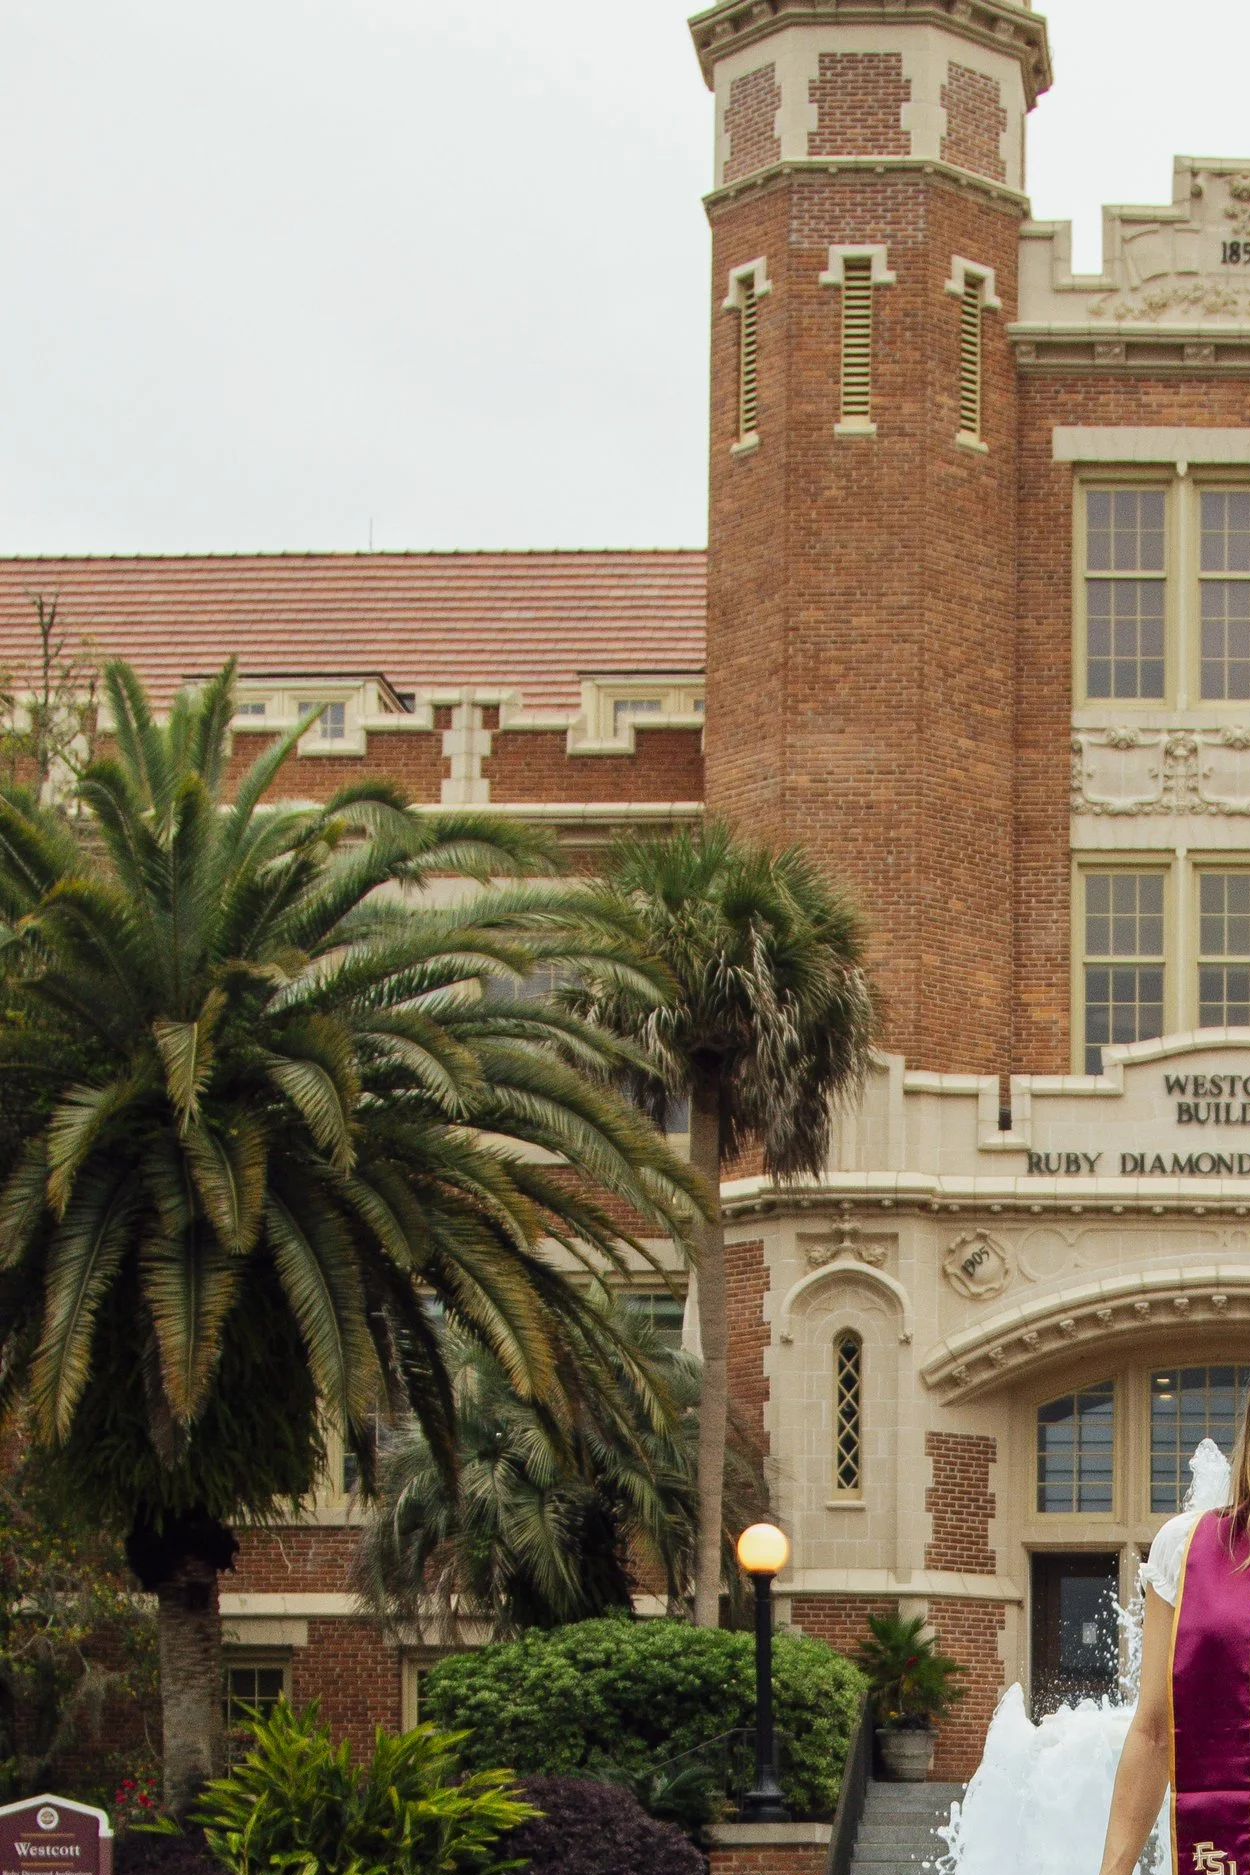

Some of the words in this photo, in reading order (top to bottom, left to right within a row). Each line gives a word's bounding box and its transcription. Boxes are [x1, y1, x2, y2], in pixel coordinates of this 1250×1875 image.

[1027, 1152, 1103, 1175] RUBY
[961, 1246, 990, 1277] 1905
[14, 1842, 81, 1856] Westcott
